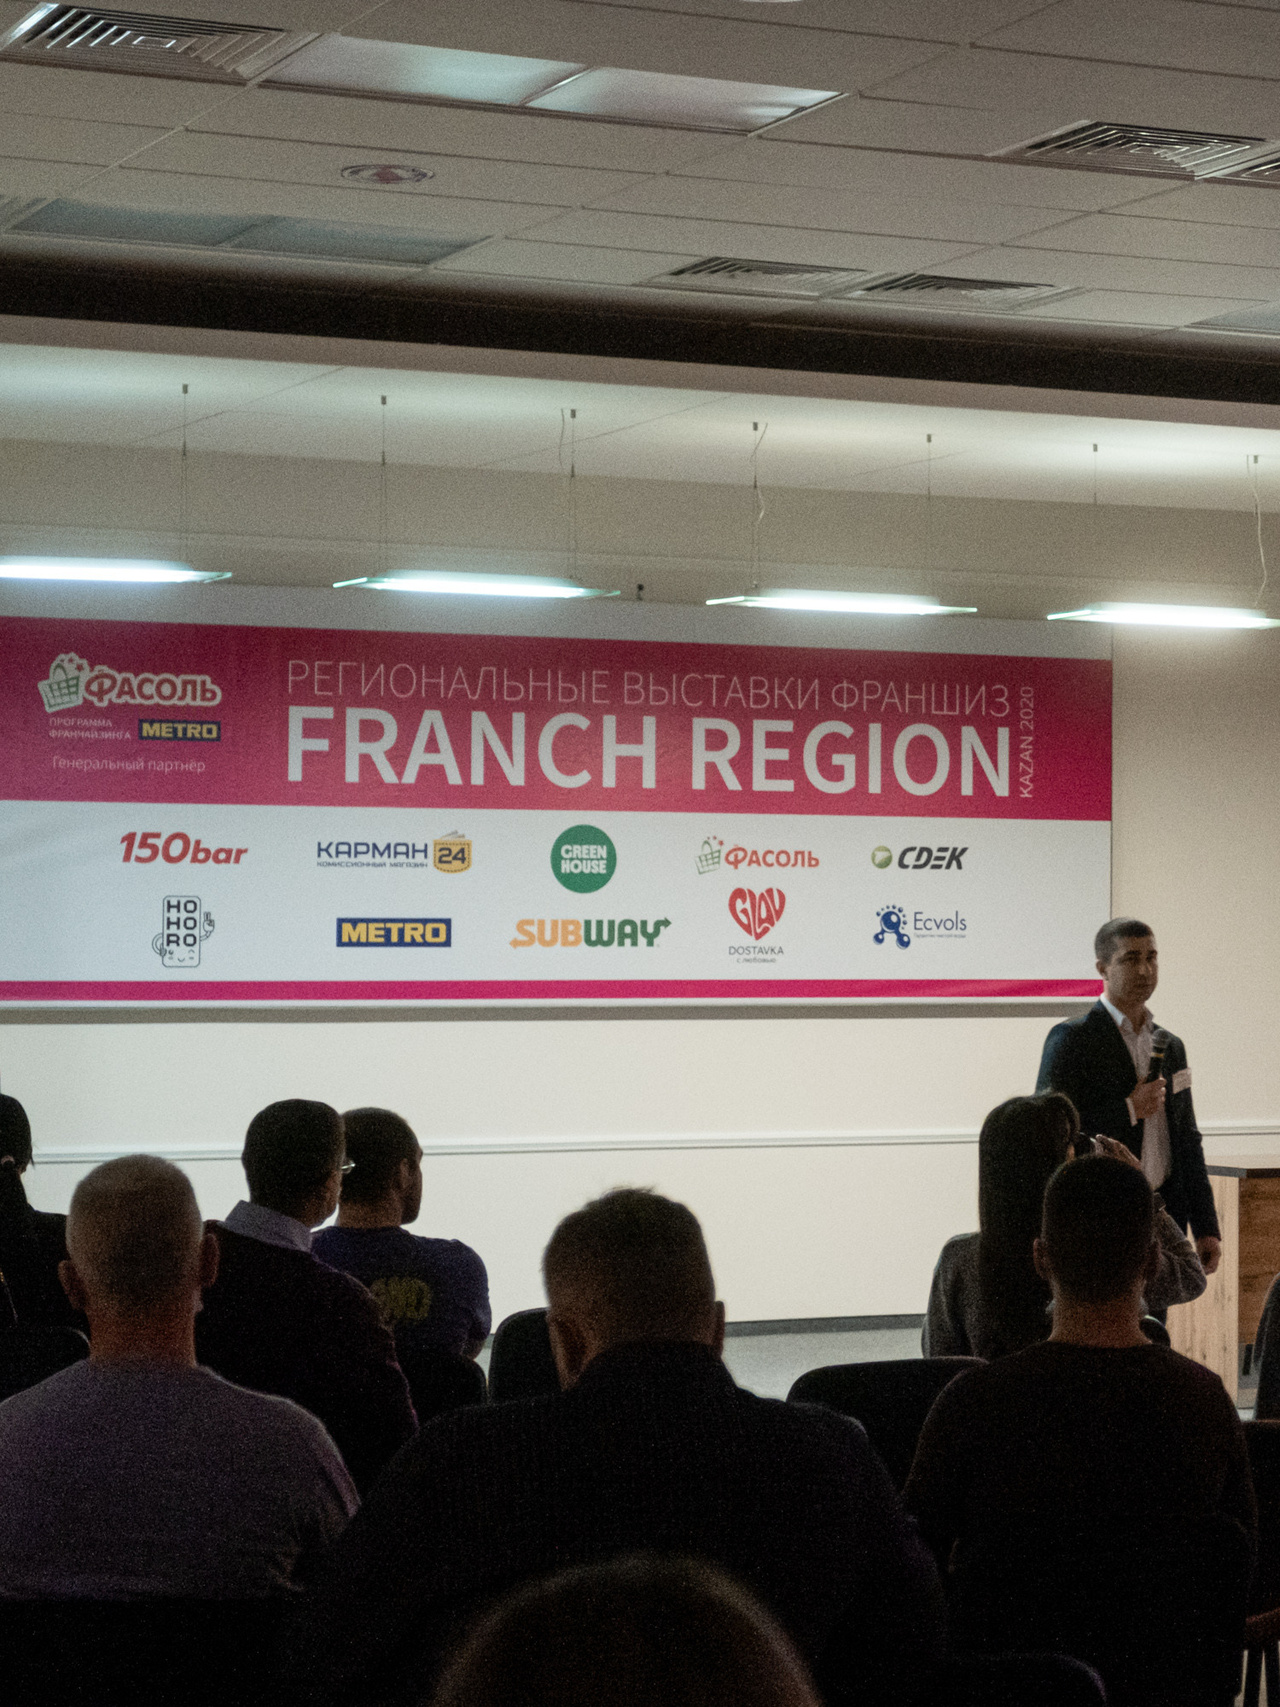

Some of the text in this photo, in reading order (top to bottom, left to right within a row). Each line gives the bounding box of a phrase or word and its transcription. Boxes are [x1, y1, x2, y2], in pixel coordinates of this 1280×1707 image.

[85, 669, 220, 706] ФАСОЛЬ
[288, 659, 1009, 717] РЕГИОНАЛЬНЫЕ ВЫСТАВКИ ФРАНШИЗ
[142, 722, 218, 739] METRO
[1020, 686, 1033, 797] KAZAN 2020
[288, 705, 1009, 797] FRANCH REGION
[53, 755, 206, 773] Генеральный партнёр
[119, 831, 248, 865] 150bar
[317, 841, 428, 859] КАРМАН
[438, 846, 467, 864] 24
[561, 844, 607, 859] GREEN
[724, 846, 820, 870] ФАСОЛЬ
[897, 846, 968, 871] CDEK
[561, 859, 607, 874] HOUSE
[914, 910, 967, 931] Ecvols
[341, 922, 447, 944] METRO
[510, 917, 671, 949] SUBWAY
[728, 946, 784, 956] DOSTAVKA
